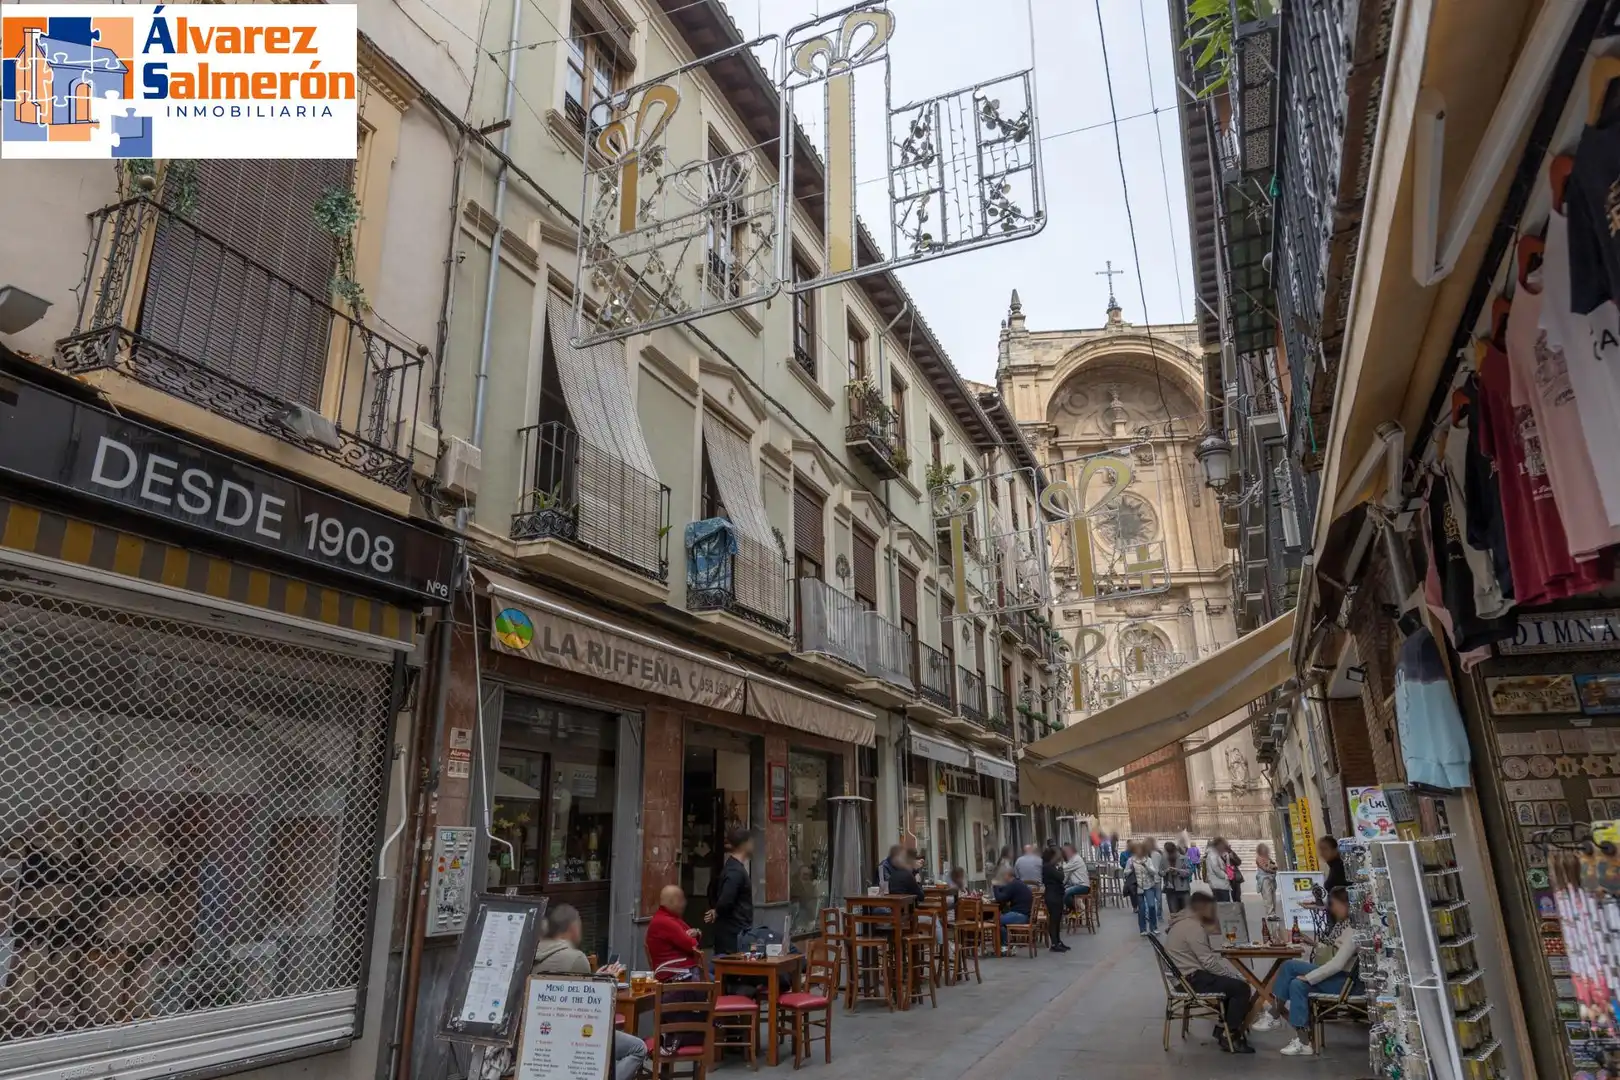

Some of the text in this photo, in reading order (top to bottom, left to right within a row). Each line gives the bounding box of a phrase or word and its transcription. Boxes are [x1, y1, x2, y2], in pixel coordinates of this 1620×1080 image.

[91, 436, 394, 573] DESDE 1908
[544, 626, 578, 660] LA
[587, 640, 682, 688] RIFFEÑA
